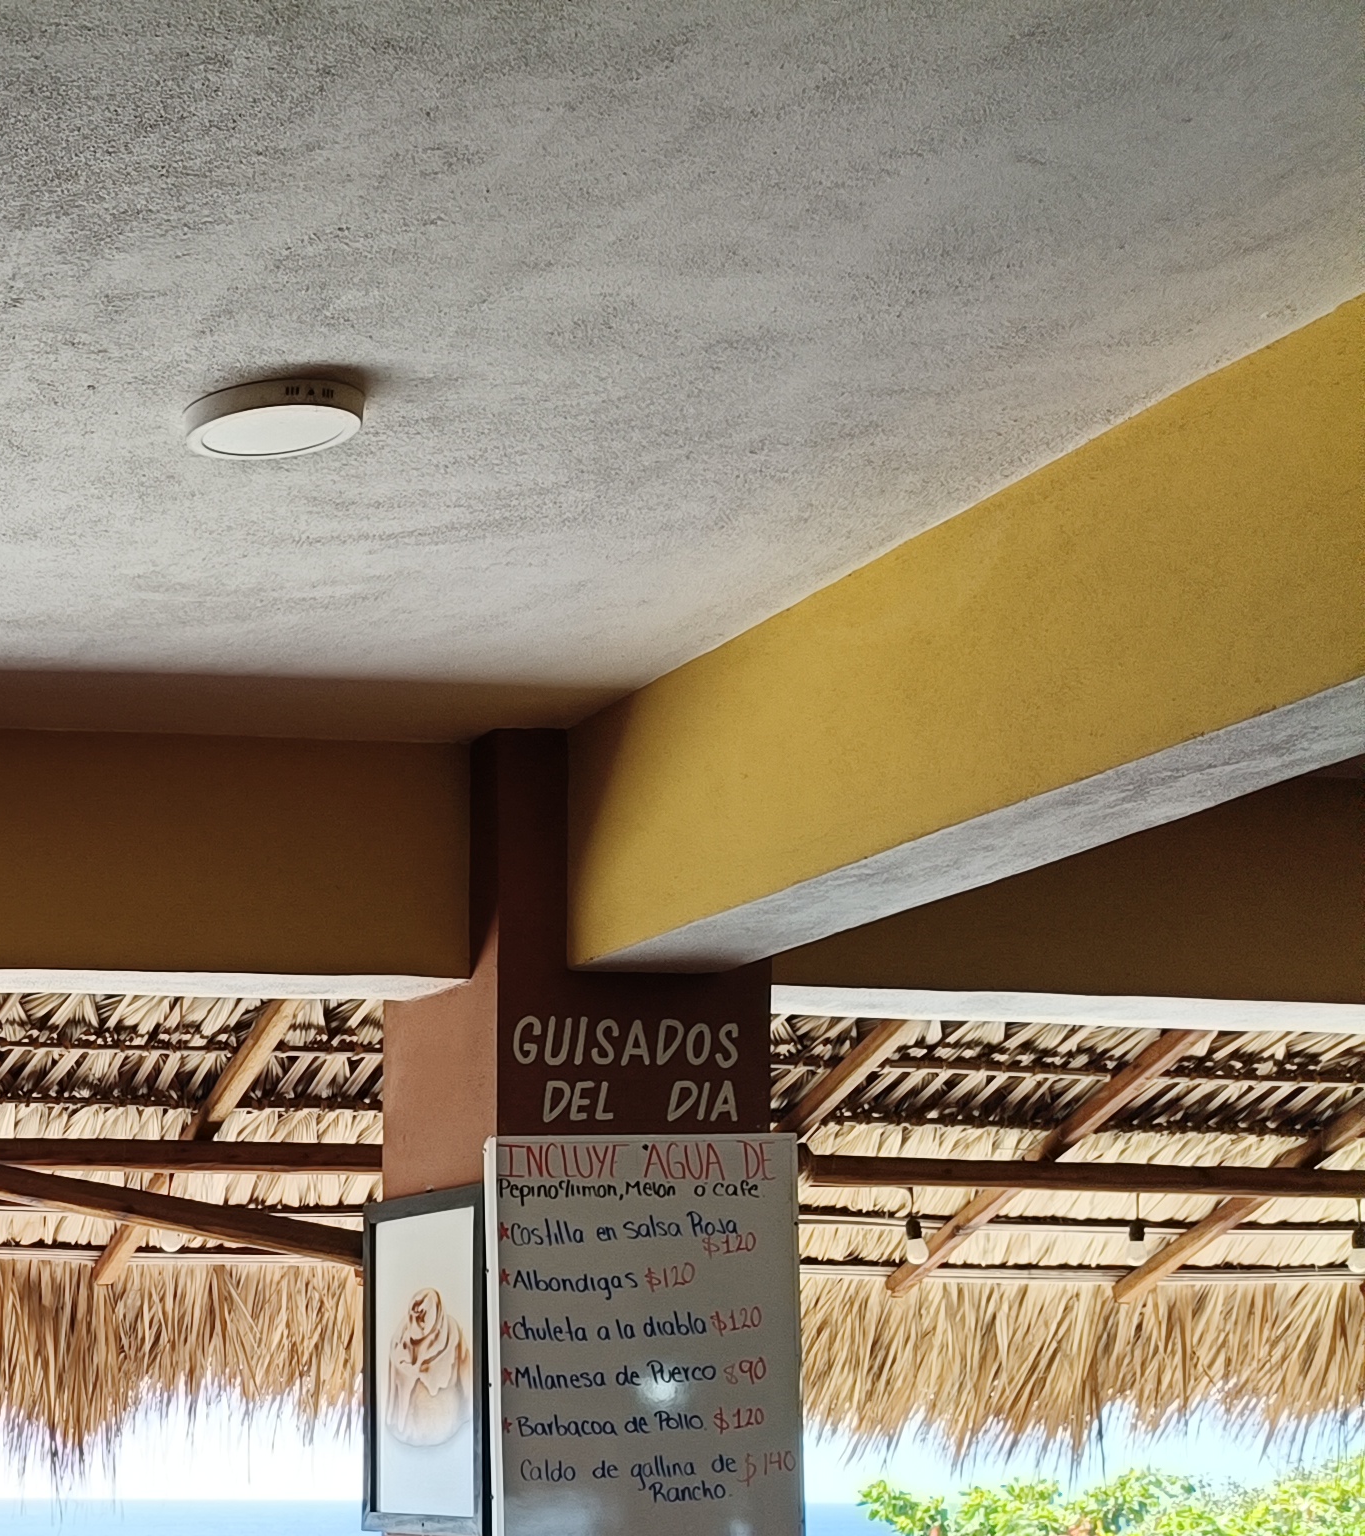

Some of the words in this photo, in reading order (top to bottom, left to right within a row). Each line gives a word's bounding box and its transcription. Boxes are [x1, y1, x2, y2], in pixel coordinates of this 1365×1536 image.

[513, 1015, 739, 1069] GUISADOS
[542, 1080, 615, 1123] DEL
[667, 1080, 738, 1122] DIA
[643, 1142, 726, 1181] AGUA
[736, 1140, 776, 1181] DE
[510, 1217, 585, 1247] Costilla
[596, 1226, 618, 1242] en
[702, 1231, 757, 1260] $120
[512, 1268, 639, 1301] Albondigas
[644, 1261, 696, 1293] $120
[512, 1315, 589, 1342] Chuleta
[597, 1325, 611, 1341] a
[615, 1318, 636, 1340] la
[643, 1310, 707, 1338] diabla
[710, 1305, 763, 1337] $120
[515, 1364, 607, 1390] Milanesa
[615, 1365, 642, 1387] de
[646, 1359, 717, 1385] Puerco
[516, 1414, 619, 1438] Barbacoa
[624, 1416, 652, 1435] de
[713, 1406, 765, 1435] $120
[520, 1458, 577, 1483] Caldo
[592, 1460, 620, 1480] de
[630, 1455, 697, 1492] gallina
[711, 1453, 738, 1473] de
[736, 1450, 797, 1488] $140
